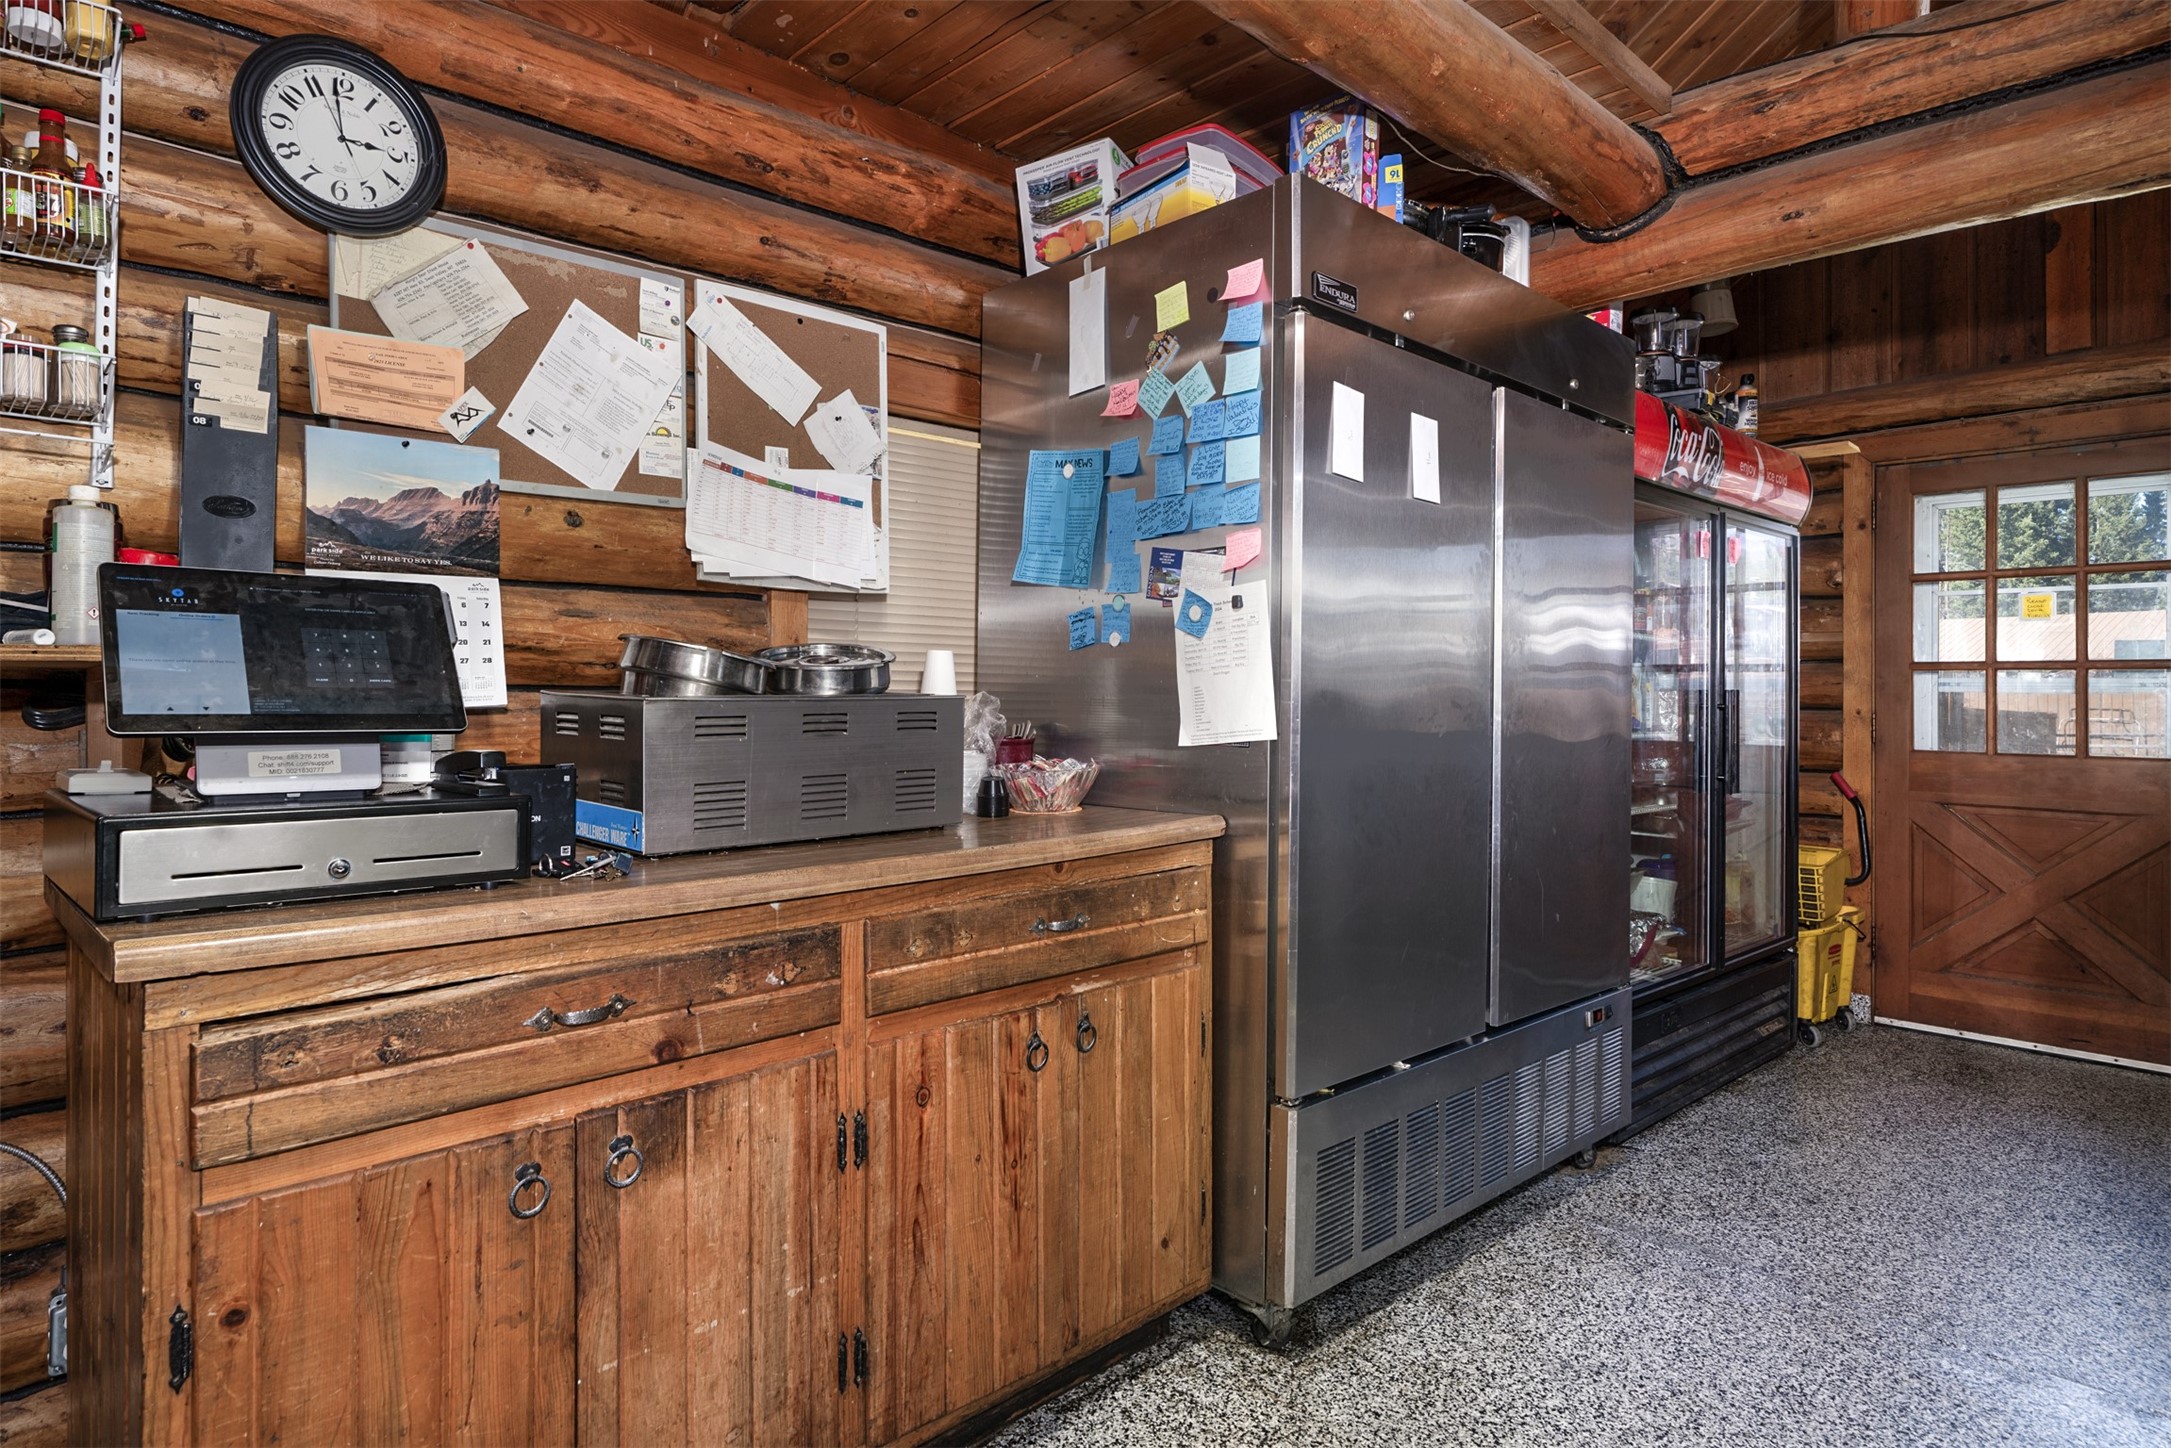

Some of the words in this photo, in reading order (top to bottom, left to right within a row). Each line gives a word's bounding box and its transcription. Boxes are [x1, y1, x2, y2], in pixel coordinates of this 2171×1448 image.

[303, 74, 324, 98] 11
[332, 76, 355, 102] 12
[278, 85, 305, 111] 10
[364, 97, 379, 112] 1
[268, 112, 294, 130] 9
[379, 120, 402, 137] 2
[276, 142, 301, 160] 8
[386, 146, 410, 164] 3
[300, 164, 323, 182] 7
[382, 169, 400, 190] 4
[330, 180, 348, 201] 6
[360, 180, 377, 202] 5
[1319, 284, 1356, 304] ENDURA
[192, 415, 207, 426] 08
[1074, 457, 1094, 469] NEWS
[1739, 461, 1757, 478] enjoy
[1766, 471, 1776, 482] ice
[1775, 474, 1788, 486] cold
[311, 547, 328, 555] park
[376, 555, 400, 563] LIKE
[401, 556, 414, 564] TO
[158, 596, 199, 604] SKYTAB
[277, 760, 335, 768] shift4.com/support
[575, 821, 611, 843] CHALLENGER
[610, 829, 629, 847] WARE
